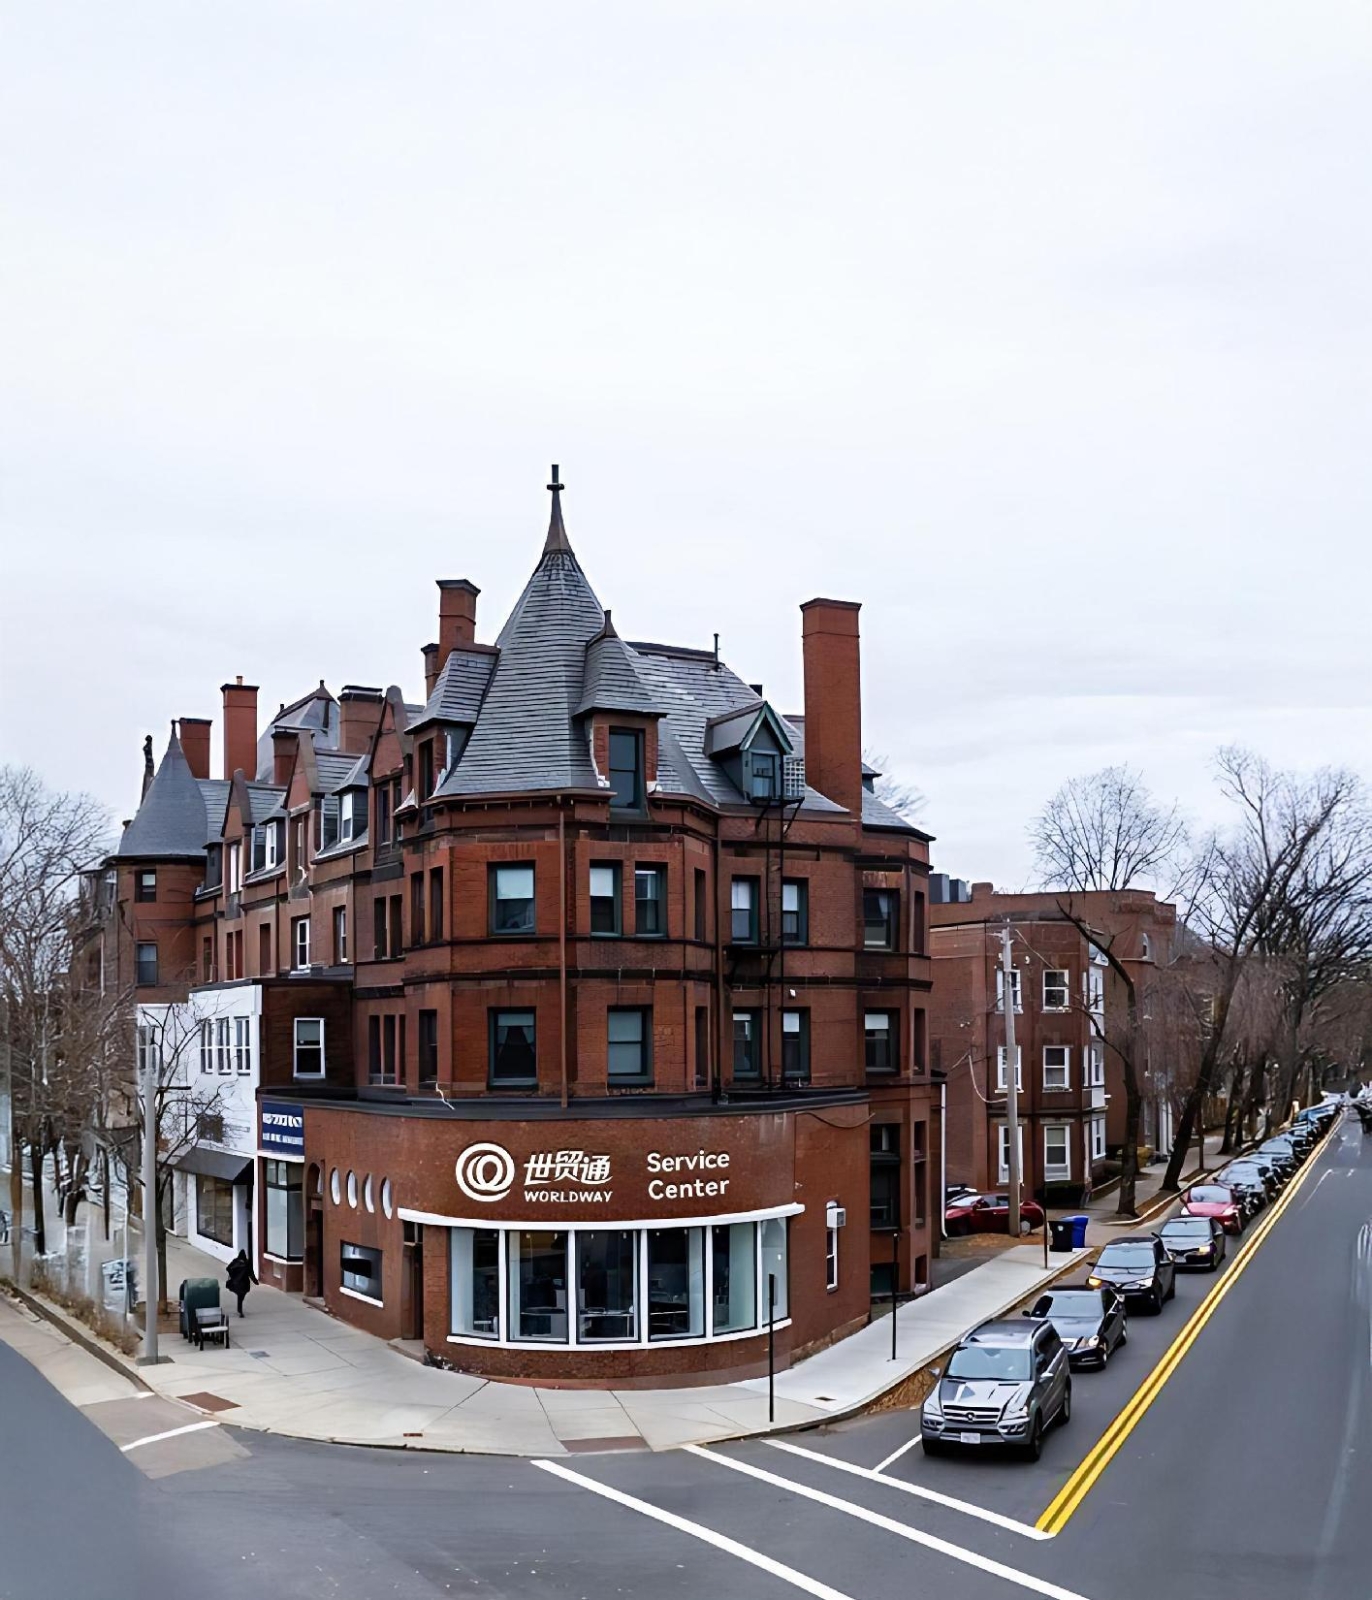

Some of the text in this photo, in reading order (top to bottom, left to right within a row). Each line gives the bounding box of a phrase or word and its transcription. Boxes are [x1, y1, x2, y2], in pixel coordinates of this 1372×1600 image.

[523, 1150, 613, 1186] 世贸通
[647, 1150, 730, 1173] Service
[524, 1190, 613, 1203] WORLDWAY
[648, 1179, 730, 1200] Center
